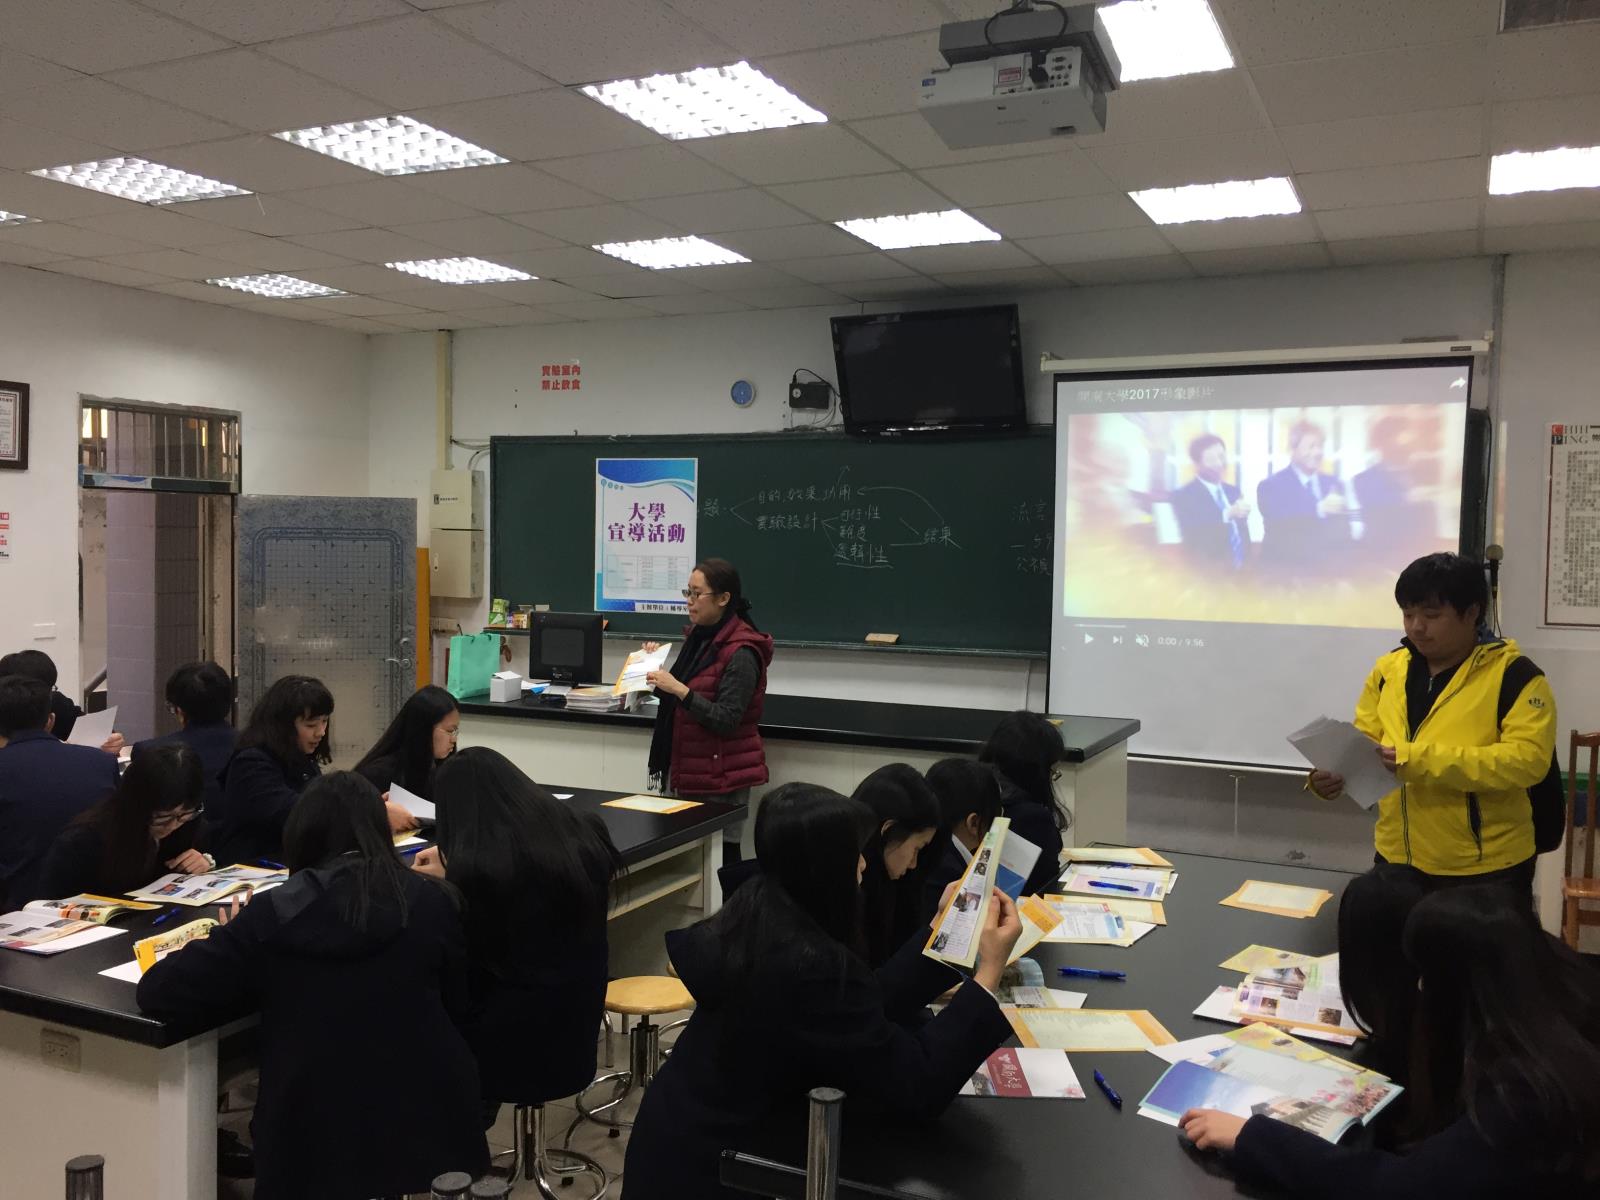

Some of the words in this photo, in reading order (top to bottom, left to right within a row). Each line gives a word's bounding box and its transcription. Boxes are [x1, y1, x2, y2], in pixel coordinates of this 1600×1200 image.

[542, 379, 581, 390] 禁止飲食
[628, 502, 667, 522] 大學
[608, 523, 686, 543] 宣導活動
